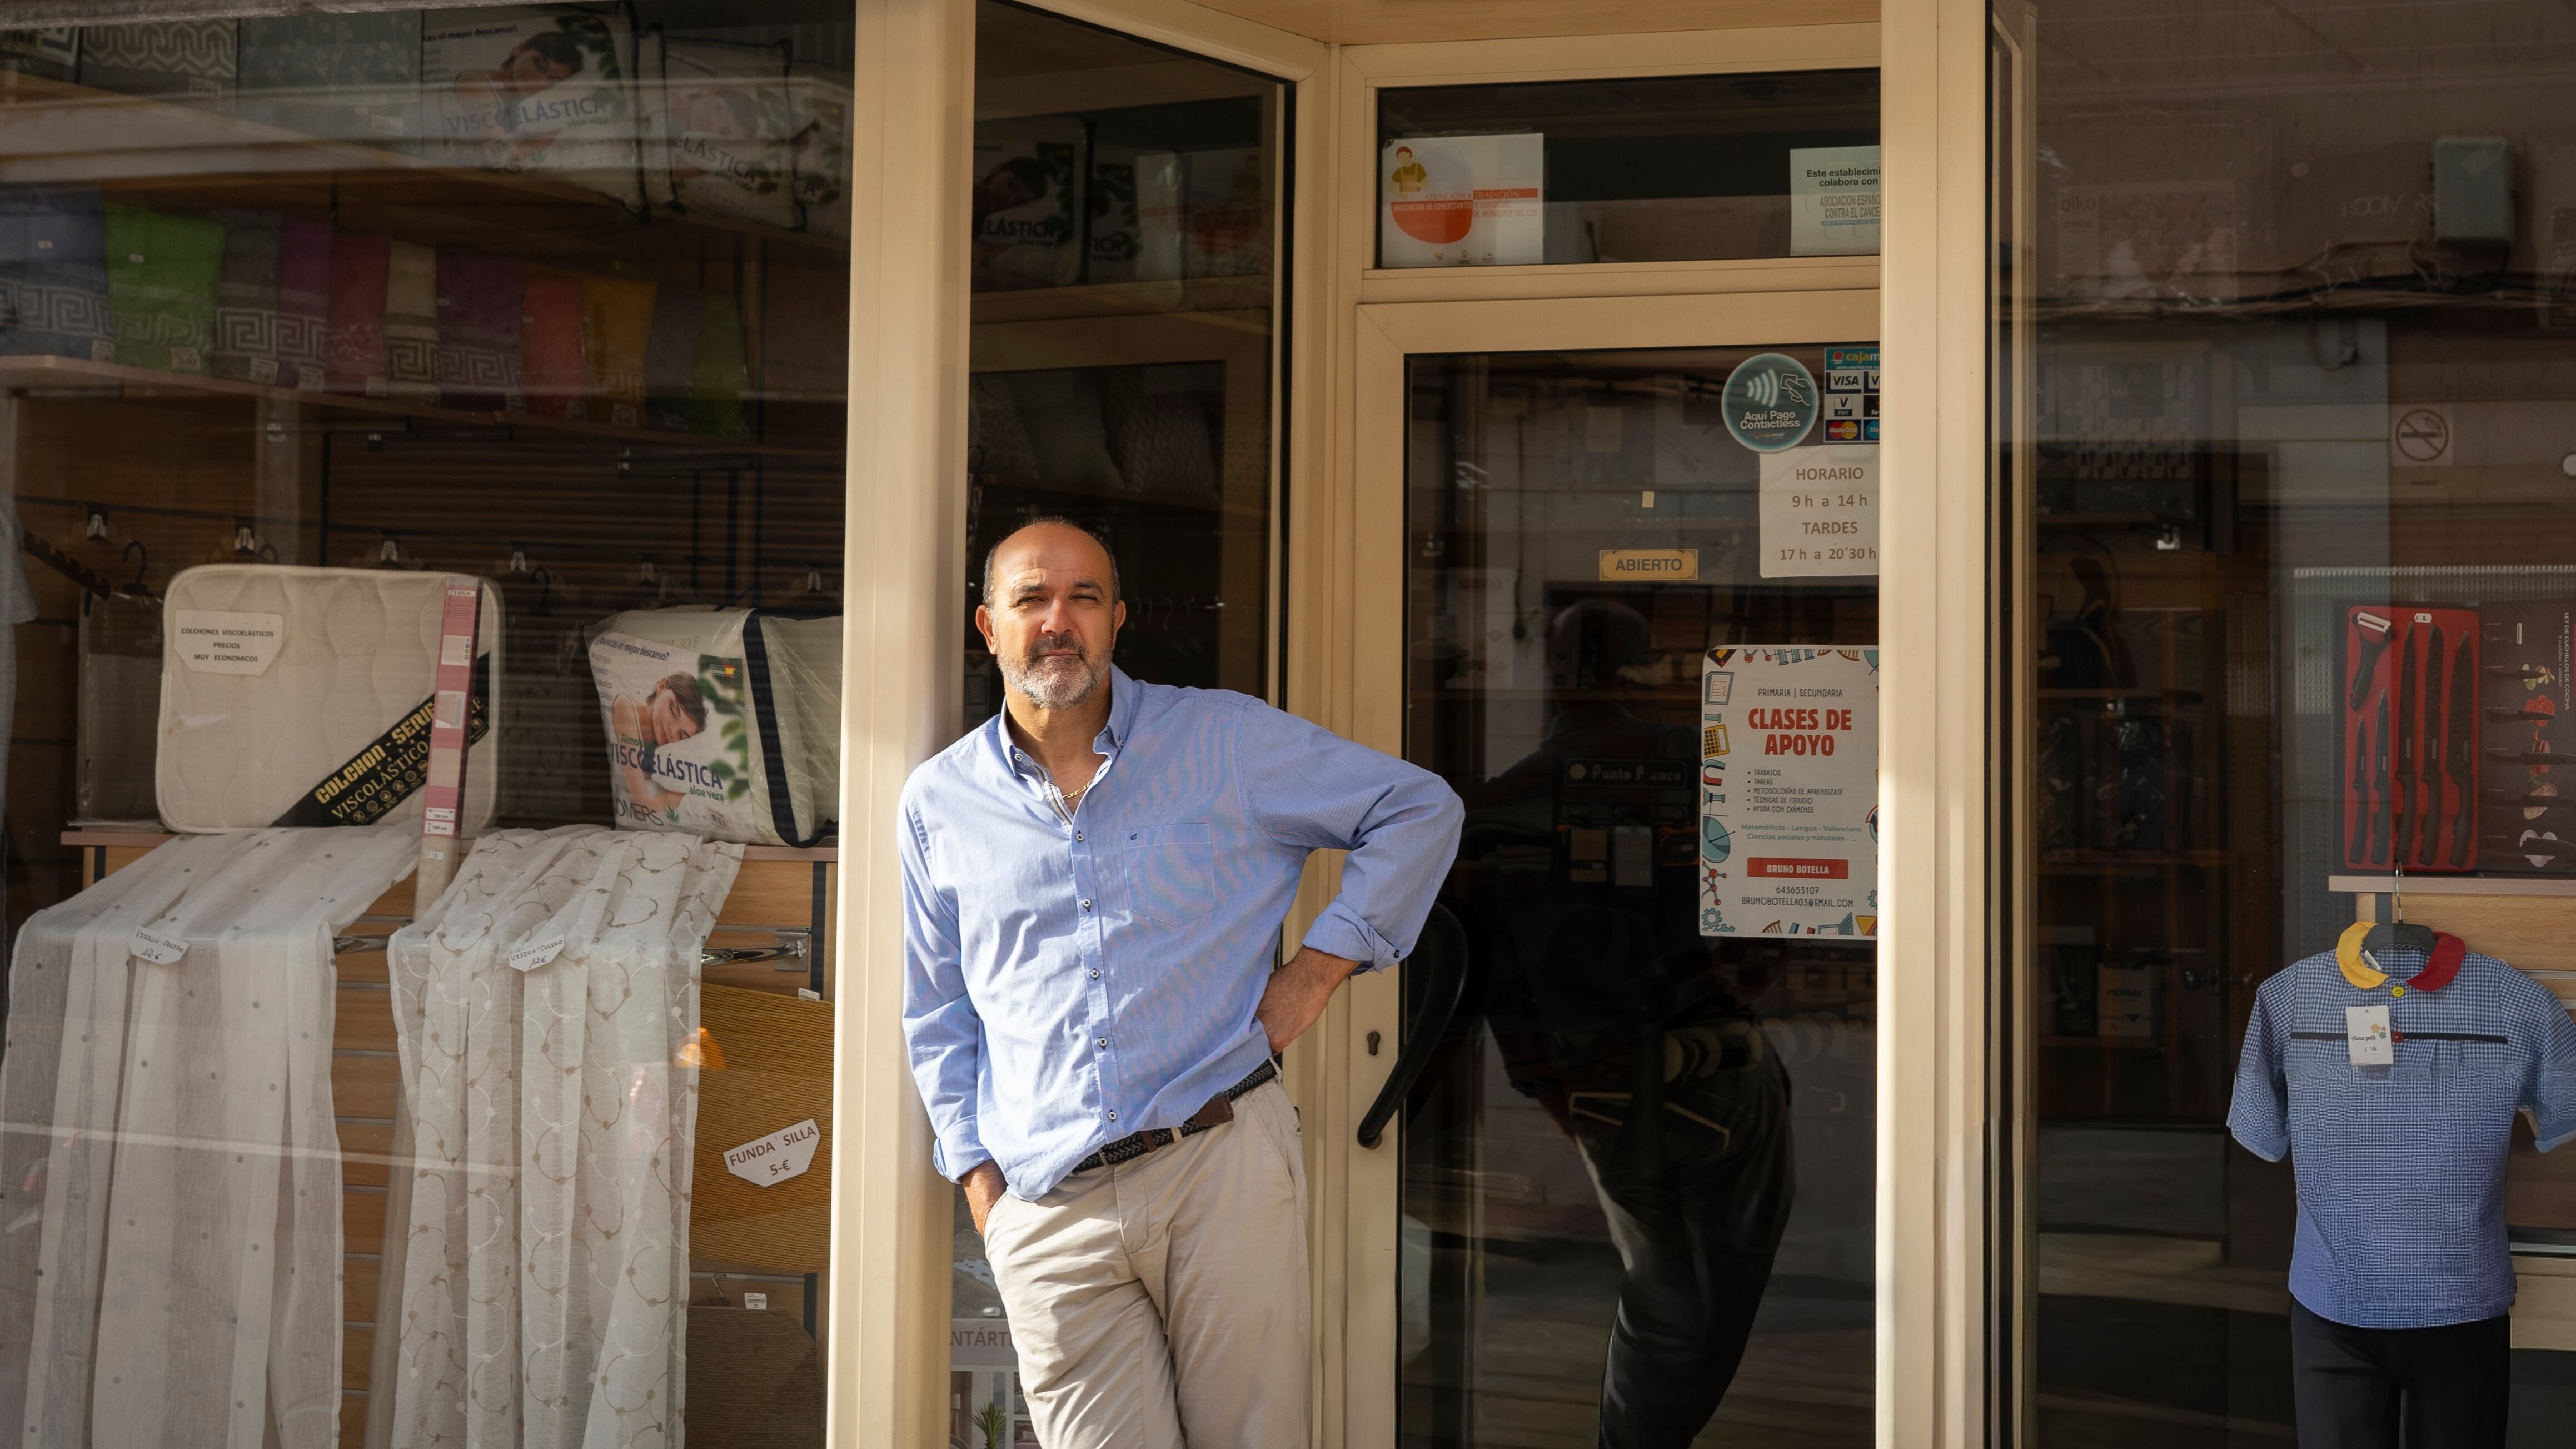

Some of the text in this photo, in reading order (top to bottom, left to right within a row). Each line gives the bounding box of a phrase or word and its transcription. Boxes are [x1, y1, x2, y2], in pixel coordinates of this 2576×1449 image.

[1807, 169, 1826, 177] Este
[1819, 178, 1858, 187] colabora
[1424, 191, 1467, 200] ATENCIÓN
[1474, 190, 1519, 199] TRADICIÓN
[1820, 195, 1856, 207] ASOCIACION
[1434, 202, 1472, 210] COMERCIANTES
[1479, 200, 1510, 209] SERVICIOS
[2060, 195, 2096, 212] oiko
[1482, 210, 1513, 218] MONFORTE
[1527, 208, 1537, 217] CID
[1825, 207, 1880, 219] CONTRA EL CANCE
[1832, 376, 1859, 386] VISA
[1743, 410, 1796, 421] Aquí Pago
[1740, 418, 1801, 430] Contactless
[1796, 467, 1864, 481] HORARIO
[1792, 494, 1867, 507] 9 h a 14 h
[1802, 521, 1858, 535] TARDES
[1780, 549, 1795, 560] 17
[1799, 548, 1806, 560] h
[1813, 551, 1821, 560] a
[1869, 547, 1876, 559] h
[1615, 558, 1683, 571] ABIERTO
[2564, 625, 2569, 634] DE
[617, 641, 624, 650] el
[624, 643, 640, 655] mejor
[640, 647, 670, 662] descanso?
[2564, 673, 2570, 683] DE
[1758, 688, 1791, 697] PRIMARIA
[1799, 689, 1843, 698] SECUNDARIA
[1748, 708, 1852, 731] CLASES DE
[1765, 734, 1835, 756] APOYO
[610, 742, 723, 790] VISCOELÁSTICA
[1592, 764, 1631, 780] Punto
[314, 744, 387, 804] COLCHON
[331, 740, 430, 819] VISCOLASTICO
[689, 785, 724, 801] aloe vera
[1753, 787, 1797, 795] METODOLOGÍAS
[1753, 795, 1778, 804] TÉCNICAS
[1787, 805, 1814, 814] EXÁMENES
[1767, 865, 1830, 874] BRUNO BOTELLA
[1776, 886, 1820, 895] 643653107
[1741, 897, 1853, 908] BRUNOBOTELLA03@GMAIL.COM
[729, 1126, 817, 1166] FUNDA SILLA
